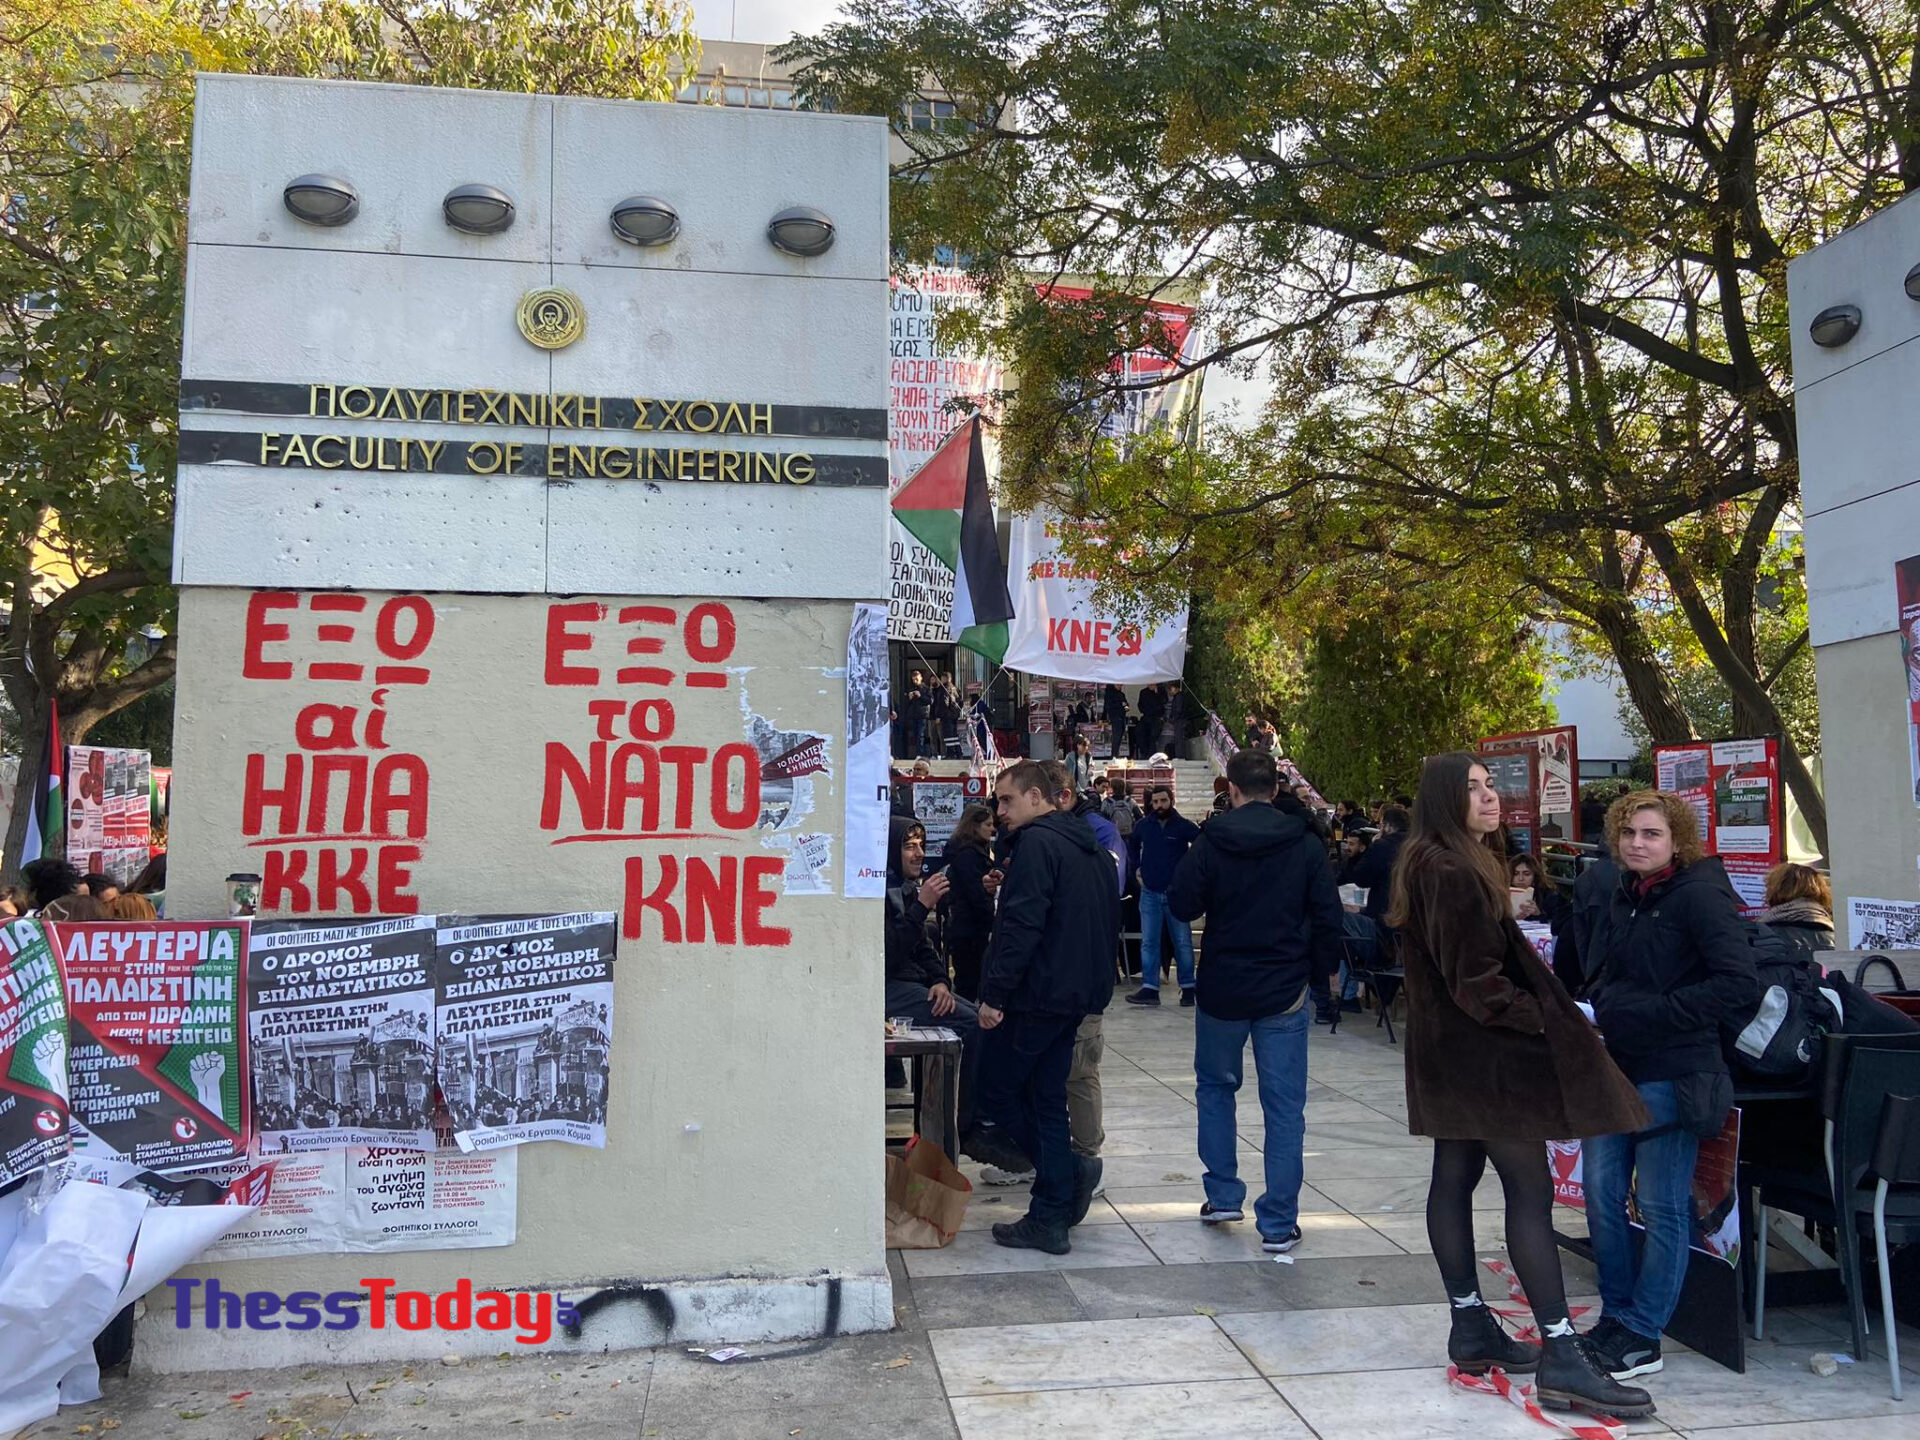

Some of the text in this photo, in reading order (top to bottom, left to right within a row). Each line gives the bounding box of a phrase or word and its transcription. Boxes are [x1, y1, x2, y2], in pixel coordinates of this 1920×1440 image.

[309, 384, 773, 434] ΠΟΛΥΤΕΧΝΙΚΗ ΣΧΟΛΗ
[261, 432, 816, 484] FACULTY OF ENGINEERING
[1047, 618, 1112, 656] ΚΝΕ
[242, 753, 429, 838] ΗΠΑ
[539, 741, 762, 832] ΝΑΤΟ
[261, 845, 425, 914] ΚΚΕ
[623, 855, 792, 947] ΚΝΕ
[266, 919, 416, 947] ΟΙ ΦΟΙΤΗΤΕΣ ΜΑΖΙ ΜΕ ΤΟΥΣ ΕΡΓΑΤΕΣ
[453, 931, 461, 941] ΟΙ
[464, 925, 504, 939] ΦΟΙΤΗΤΕΣ
[505, 923, 525, 935] ΜΑΖΙ
[527, 921, 539, 932] ΜΕ
[541, 918, 561, 930] ΤΟΥΣ
[66, 930, 234, 961] ΛΕΥΤΕΡΙΑ
[262, 943, 373, 971] Ο ΔΡΟΜΟΣ
[450, 950, 465, 965] Ο
[124, 963, 165, 976] ΣΤΗΝ
[276, 953, 420, 985] ΤΟΥ ΝΟΕΜΒΡΗ
[465, 947, 599, 980] ΤΟΥ ΝΟΕΜΒΡΗ
[68, 976, 232, 1003] ΠΑΛΑΙΣΤΙΝΗ
[258, 970, 427, 1004] ΕΠΑΝΑΣΤΑΤΙΚΟΣ
[445, 964, 607, 998] ΕΠΑΝΑΣΤΑΤΙΚΟΣ
[96, 1006, 232, 1024] ΑΠΟ ΤΟΝ ΙΟΡΔΑΝΗ
[260, 1002, 389, 1025] ΛΕΥΤΕΡΙΑ ΣΤΗΝ
[446, 993, 572, 1021] ΛΕΥΤΕΡΙΑ ΣΤΗΝ
[261, 1017, 370, 1038] ΠΑΛΑΙΣΤΙΝΗ
[446, 1007, 553, 1036] ΠΑΛΑΙΣΤΙΝΗ
[109, 1027, 233, 1045] ΜΕΧΡΙ ΤΗ ΜΕΣΟΓΕΙΟ
[84, 1071, 100, 1086] ΤΟ
[72, 1090, 160, 1113] ΤΡΟΜΟΚΡΑΤΗ
[88, 1107, 137, 1126] ΙΣΡΑΗΛ
[291, 1135, 349, 1147] Σοσιαλιστικό
[350, 1134, 390, 1145] Εργατικό
[474, 1131, 526, 1147] οσιαλιστικό
[528, 1127, 566, 1139] Εργατικό
[357, 1186, 375, 1195] του
[371, 1199, 425, 1214] ζωντανή
[262, 1227, 308, 1239] ΣΥΛΛΟΓΟΙ
[382, 1220, 478, 1234] ΦΟΙΤΗΤΙΚΟΙ ΣΥΛΛΟΓΟΙ
